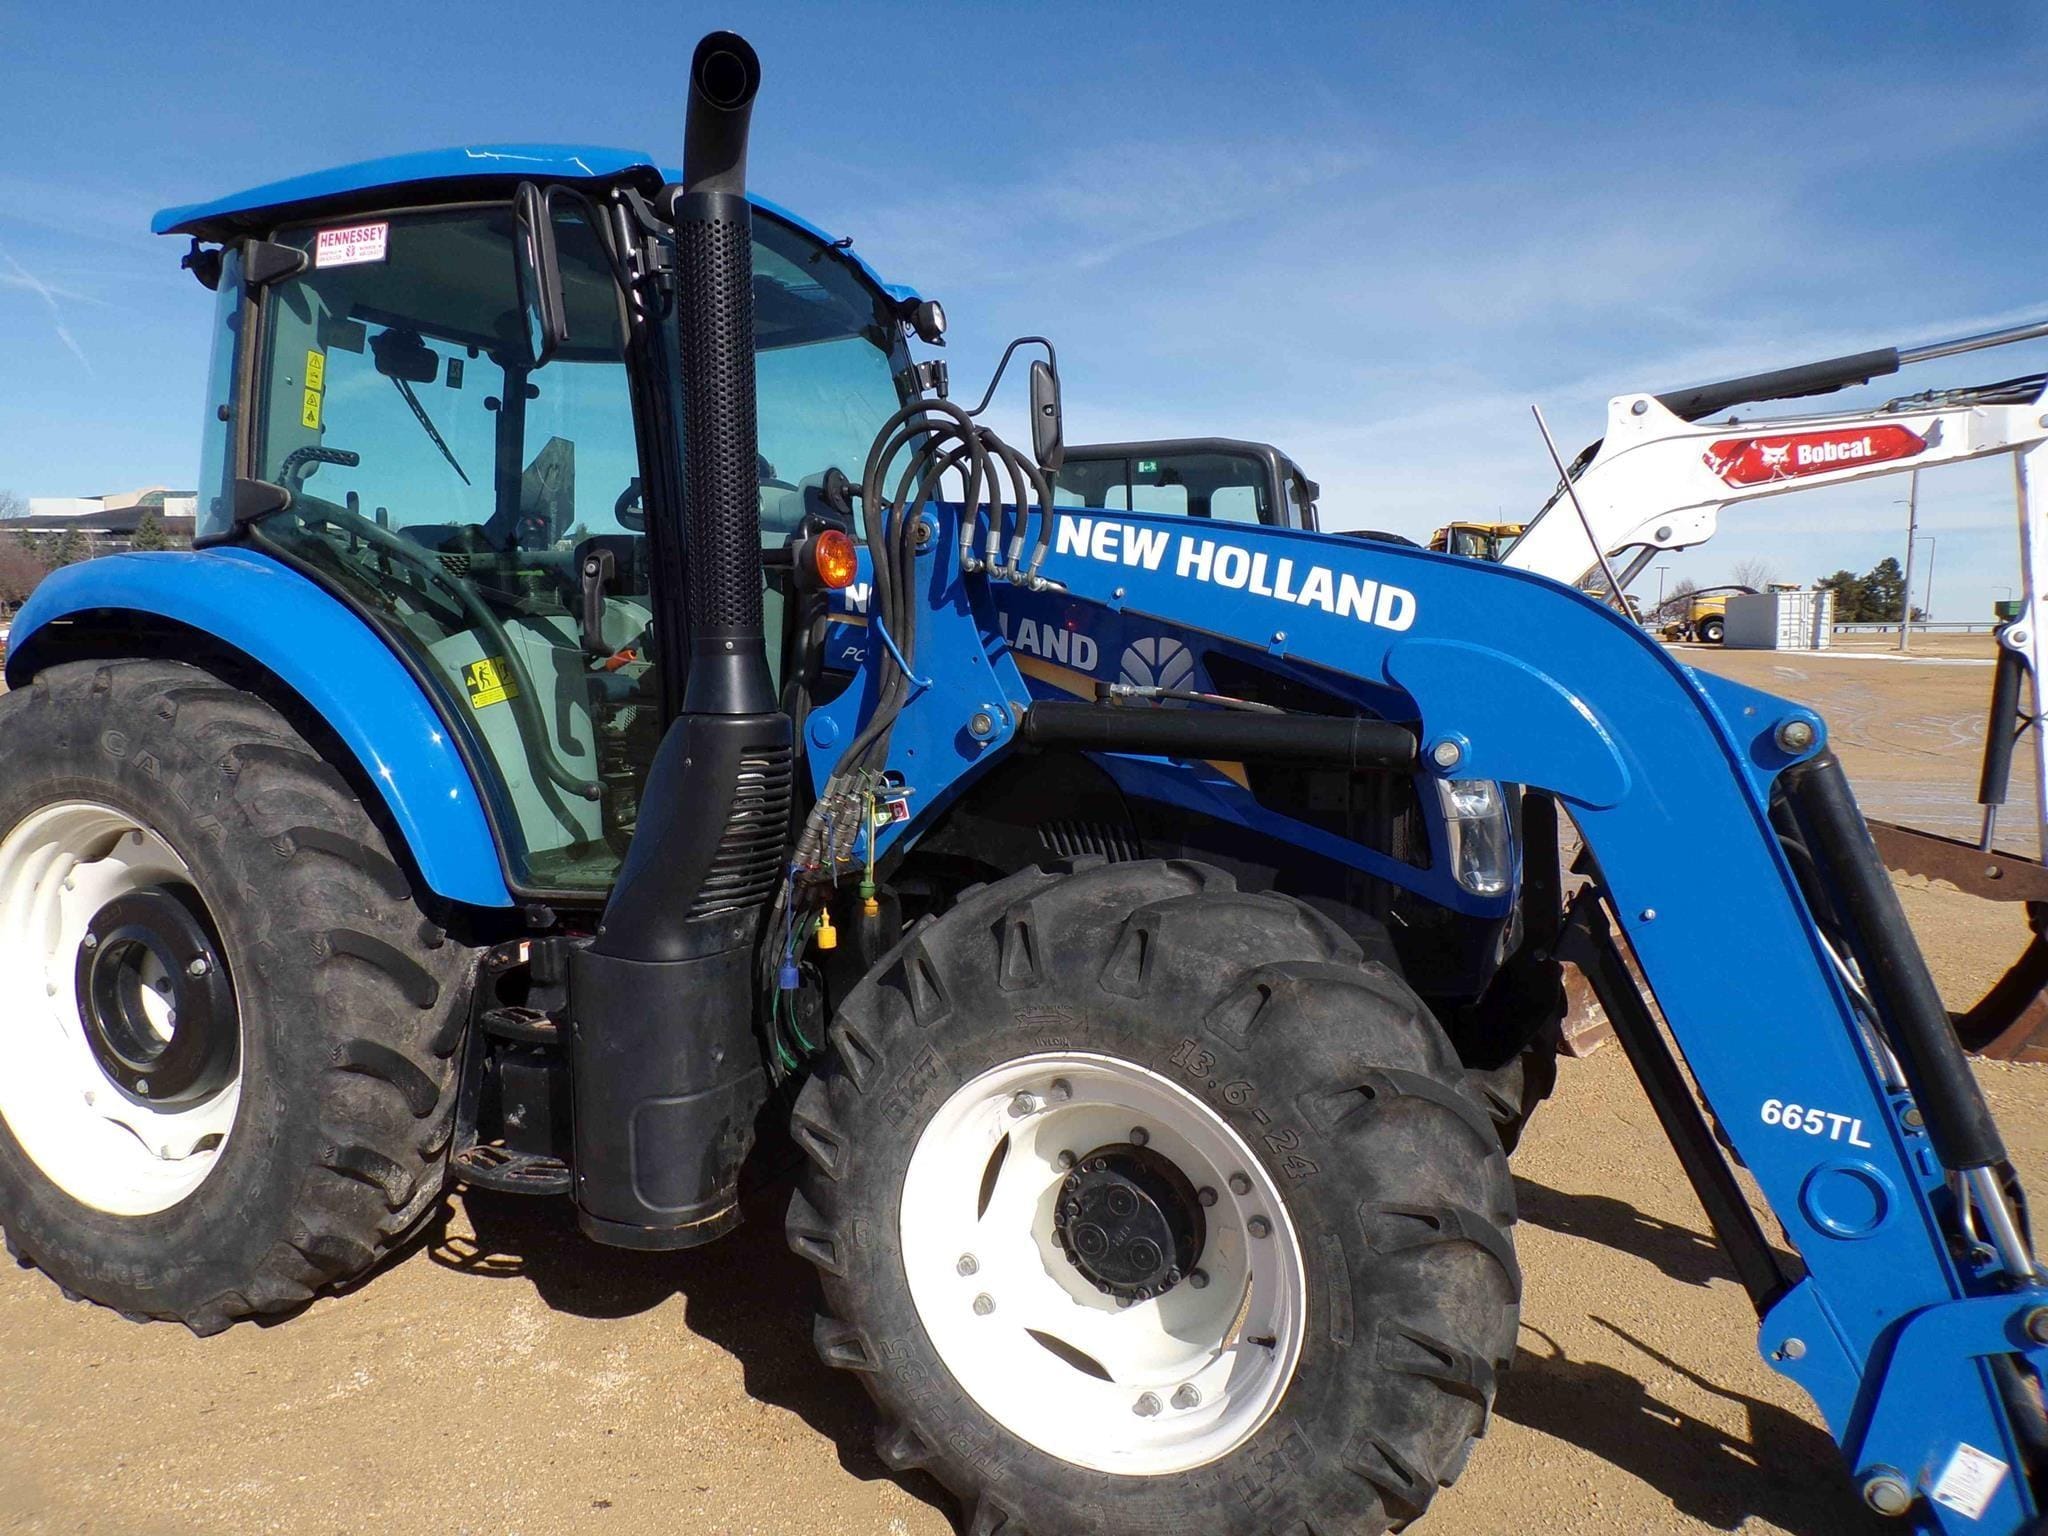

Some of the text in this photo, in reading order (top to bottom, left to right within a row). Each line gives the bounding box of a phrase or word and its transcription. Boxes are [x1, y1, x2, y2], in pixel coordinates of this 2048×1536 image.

[320, 226, 385, 248] HENNESSEY
[1797, 437, 1872, 465] Bobcat
[1056, 515, 1416, 631] NEW HOLLAND
[1170, 1039, 1320, 1180] 13.6-24
[1761, 1099, 1871, 1149] 665TL
[879, 1338, 1009, 1482] TR-135
